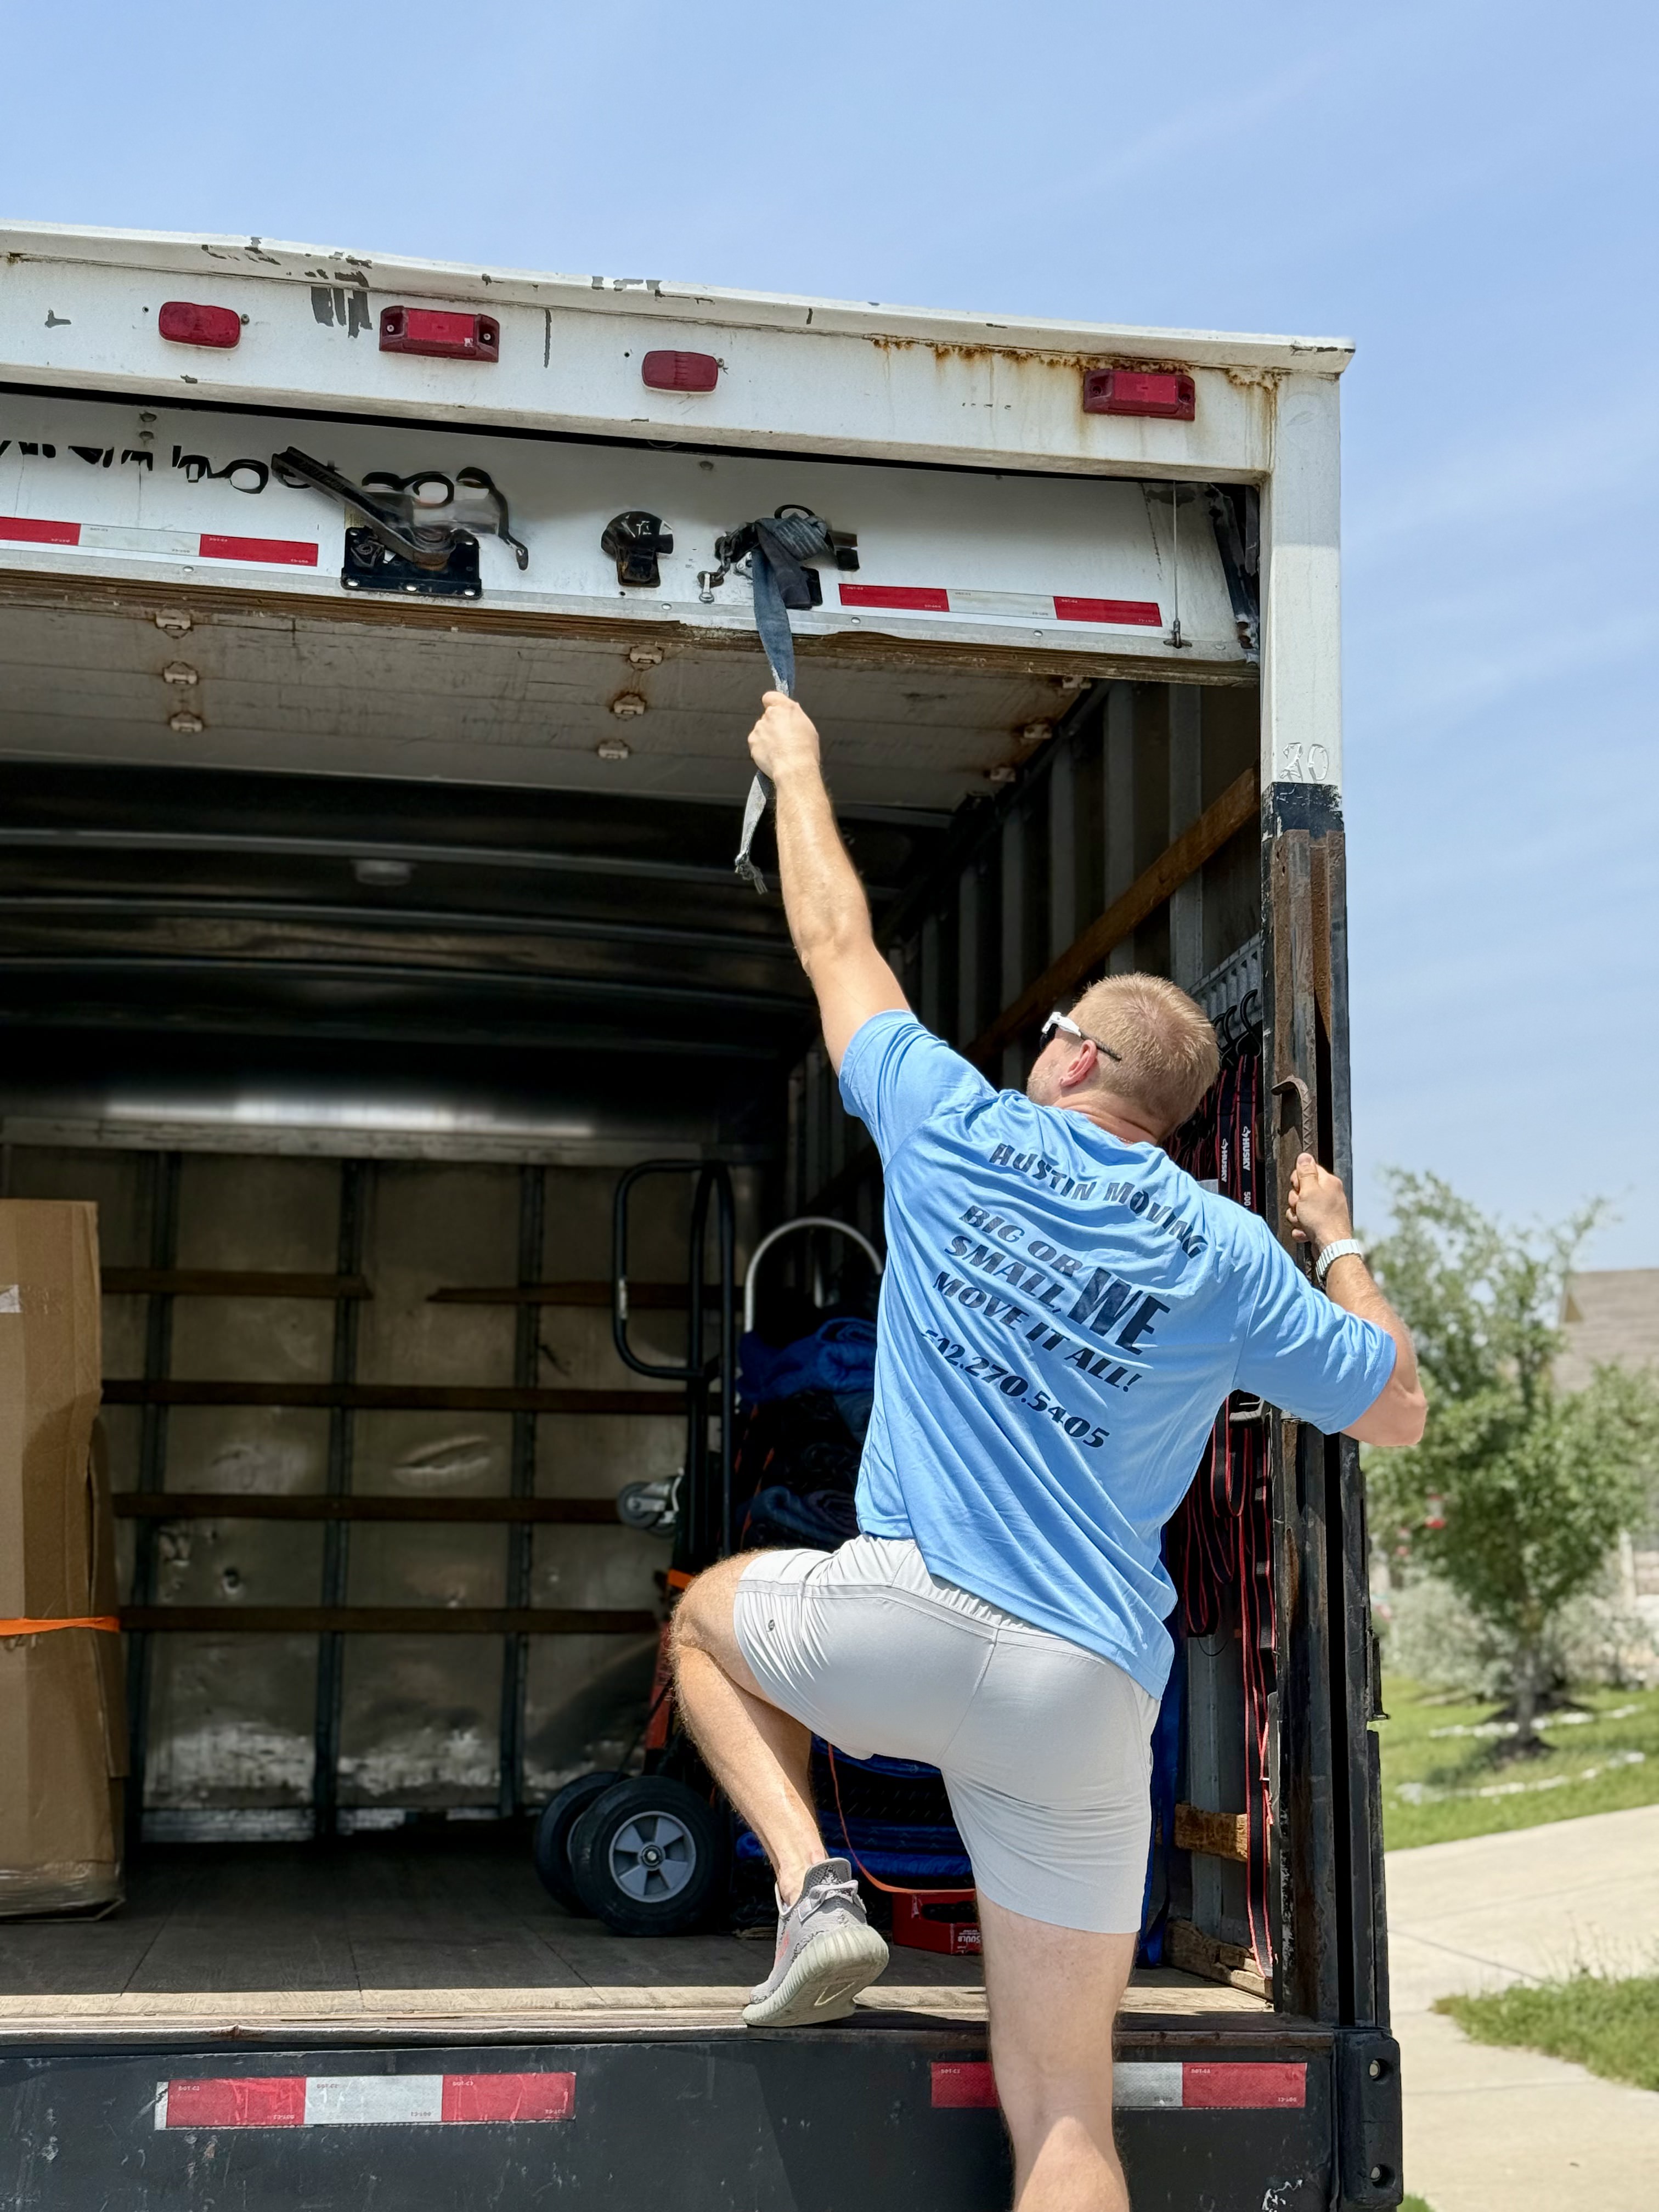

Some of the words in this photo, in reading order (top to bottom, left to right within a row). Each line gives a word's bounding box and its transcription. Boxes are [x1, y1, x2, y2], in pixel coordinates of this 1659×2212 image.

[989, 1143, 1097, 1201] AUSTIN
[1103, 1182, 1208, 1259] MOVING
[1242, 1137, 1251, 1171] HUSKY
[944, 1235, 1067, 1313] SMALL,
[1067, 1267, 1171, 1356] WE
[958, 1205, 1025, 1243] BIG
[1028, 1240, 1084, 1278] OR
[932, 1272, 1029, 1331] MOVE
[1025, 1321, 1070, 1351] IT
[1068, 1347, 1143, 1392] ALL!
